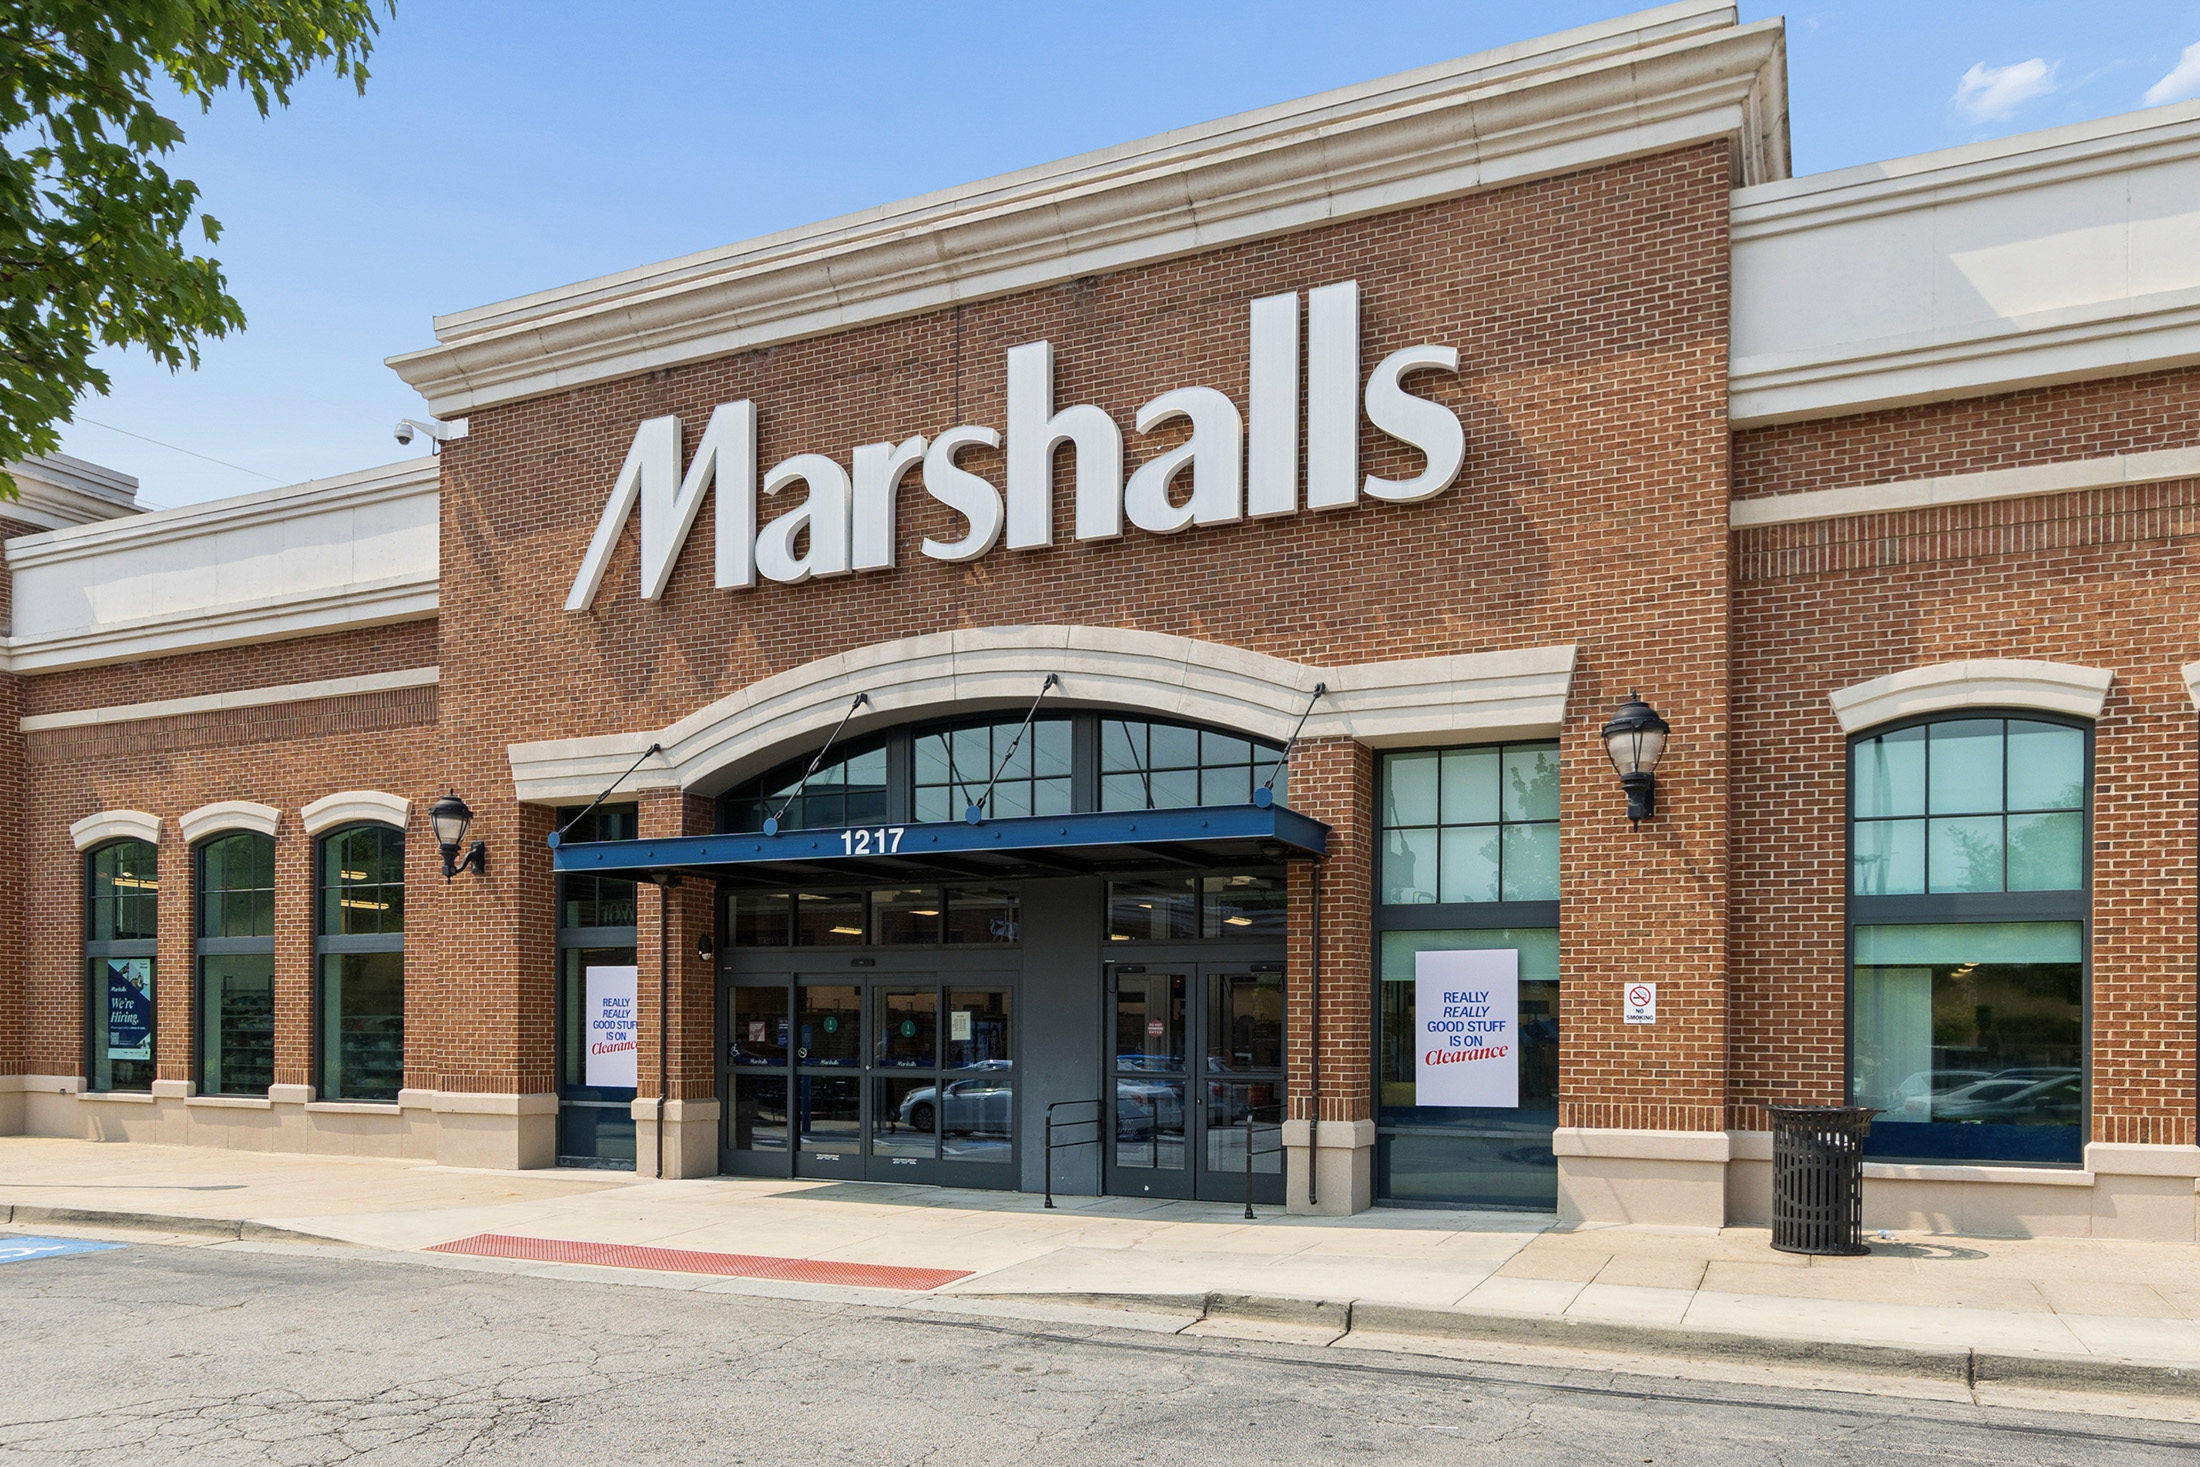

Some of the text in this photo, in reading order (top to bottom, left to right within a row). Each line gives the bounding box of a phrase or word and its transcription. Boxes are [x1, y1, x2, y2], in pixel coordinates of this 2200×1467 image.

[564, 279, 1467, 613] Marshalls
[840, 827, 905, 855] 1217
[602, 998, 630, 1007] REALLY
[1443, 991, 1489, 1003] REALLY
[111, 997, 135, 1010] We're
[602, 1009, 631, 1018] REALLY
[1443, 1006, 1491, 1018] REALLY
[110, 1011, 140, 1026] Hiring.
[593, 1020, 616, 1030] GOOD
[1427, 1020, 1507, 1033] GOOD STUFF
[606, 1031, 627, 1041] IS ON
[1449, 1035, 1483, 1047] IS ON
[591, 1040, 638, 1056] Clearanc
[1425, 1045, 1509, 1067] Clearance
